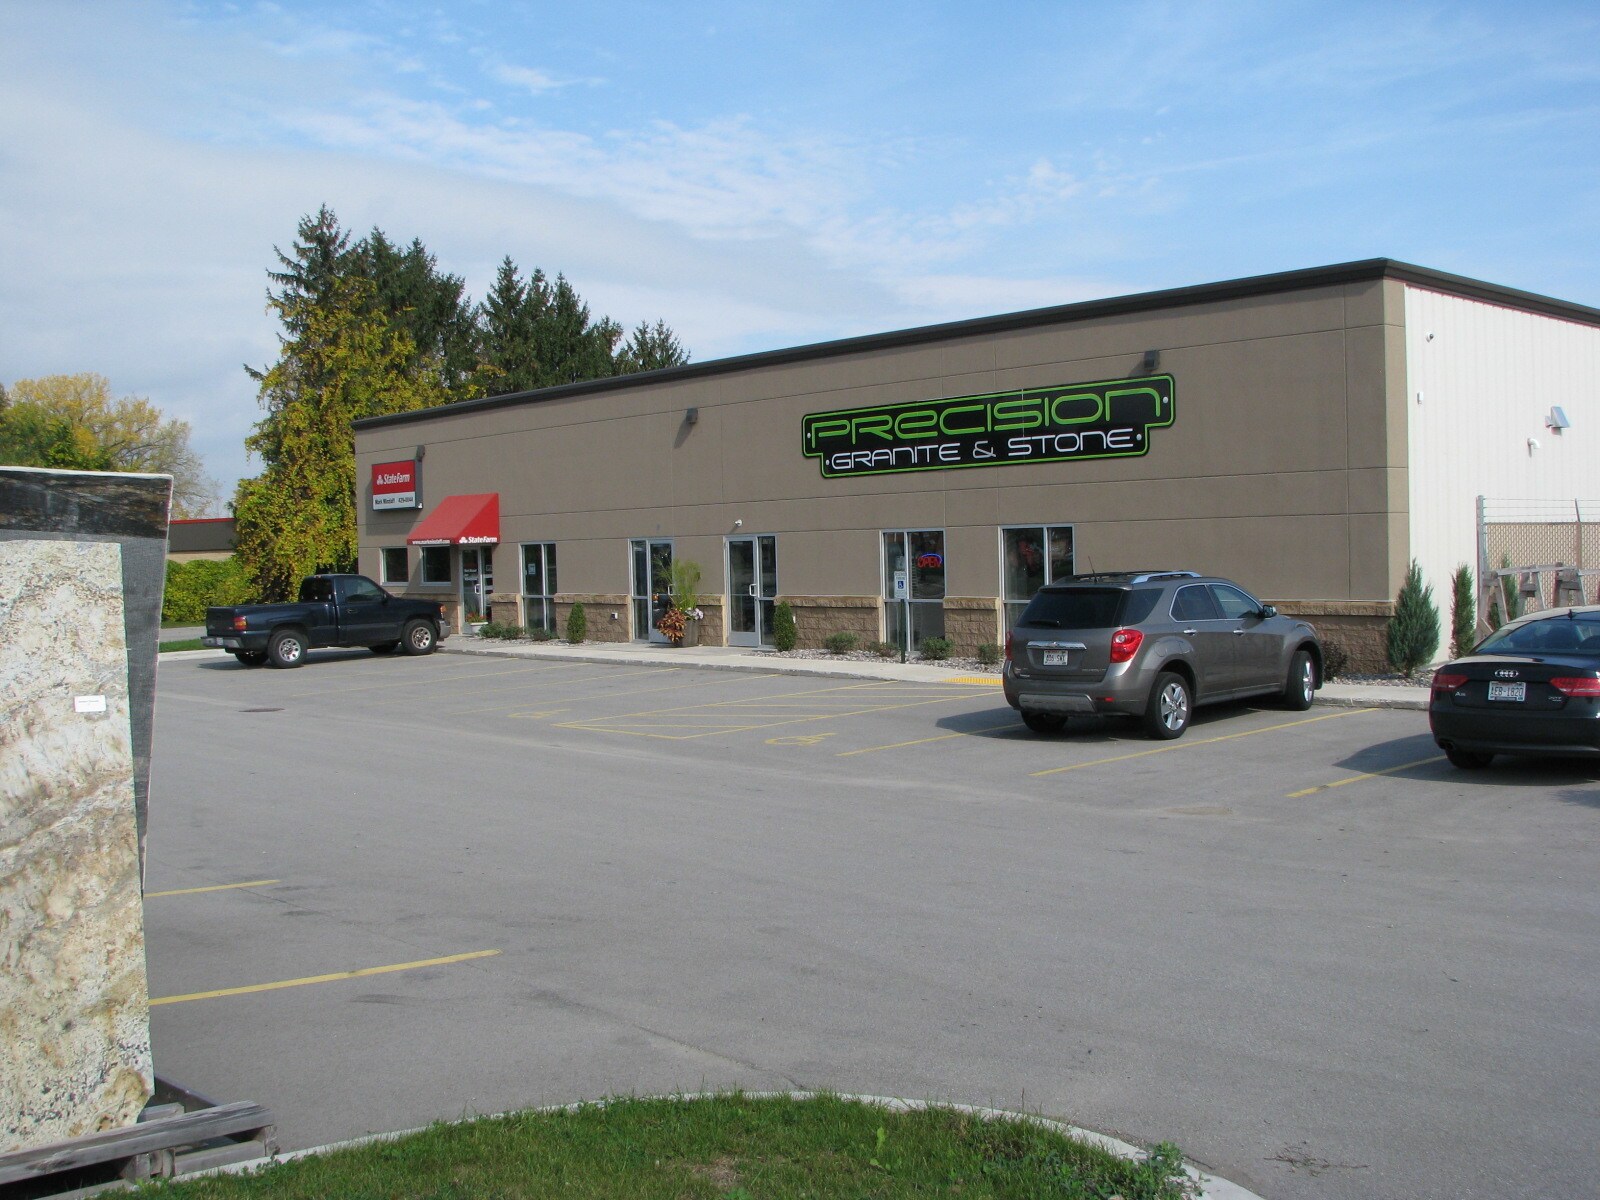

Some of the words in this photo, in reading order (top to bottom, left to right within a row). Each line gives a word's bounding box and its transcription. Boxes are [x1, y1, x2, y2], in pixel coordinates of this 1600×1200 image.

[811, 387, 1162, 449] PRECISION
[831, 442, 961, 470] GRANITE
[972, 440, 997, 459] &
[1007, 428, 1134, 456] STONE
[917, 556, 941, 568] OPEN
